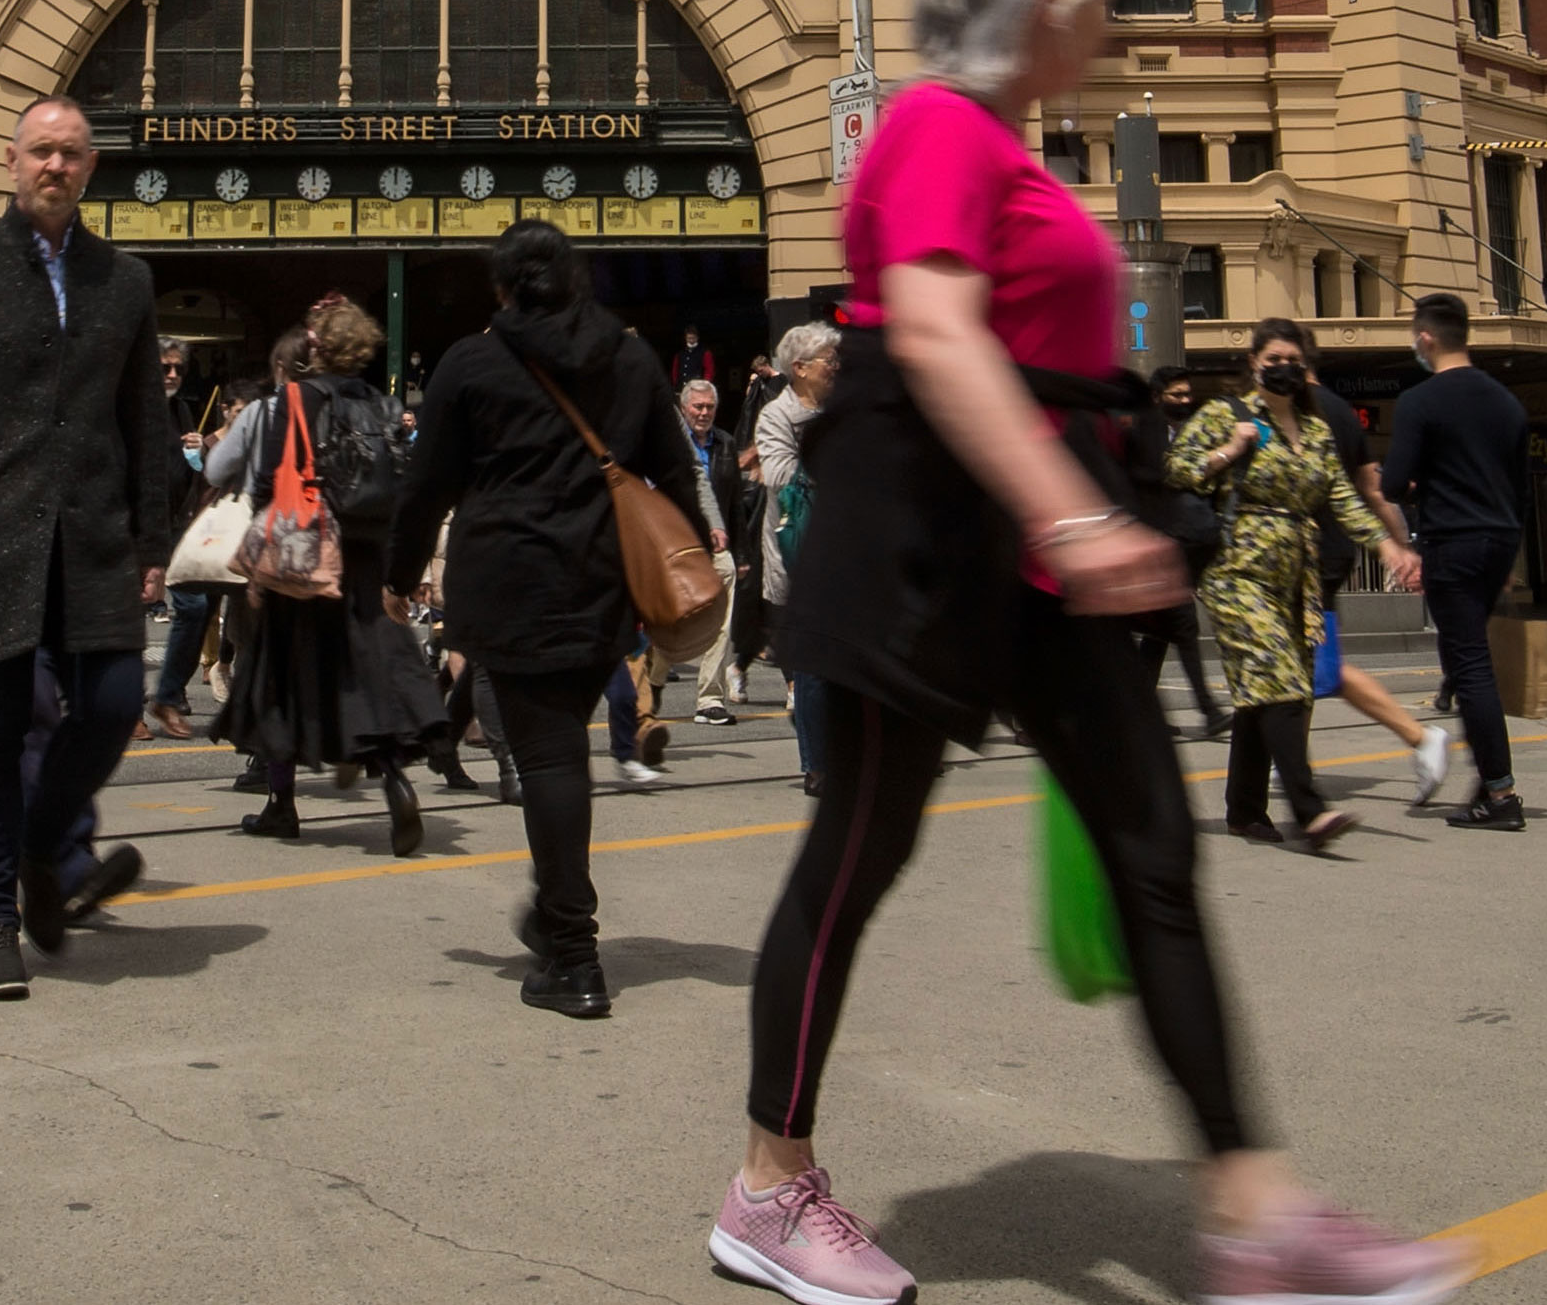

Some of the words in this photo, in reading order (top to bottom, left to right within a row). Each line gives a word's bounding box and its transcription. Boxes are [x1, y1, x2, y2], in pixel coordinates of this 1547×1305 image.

[832, 99, 872, 115] CLEARWAY
[144, 116, 297, 142] FLINDERS
[340, 115, 458, 141] STREET
[498, 113, 641, 140] STATION
[114, 203, 161, 214] FRANKSTON
[196, 202, 254, 213] SANDRINGHAM
[279, 202, 339, 212] WILLIAMSTOWN
[361, 201, 392, 210] ALTONA
[443, 201, 453, 210] ST
[455, 201, 485, 210] ALBANS
[524, 201, 593, 210] BROADMEADOWS
[607, 200, 640, 209] UPFIELD
[689, 200, 729, 209] WERRIBEE
[114, 215, 132, 225] LINE
[196, 214, 214, 224] LINE
[279, 213, 296, 222] LINE
[361, 212, 378, 221] LINE
[443, 212, 460, 221] LINE
[607, 211, 625, 220] LINE
[689, 211, 706, 220] LINE
